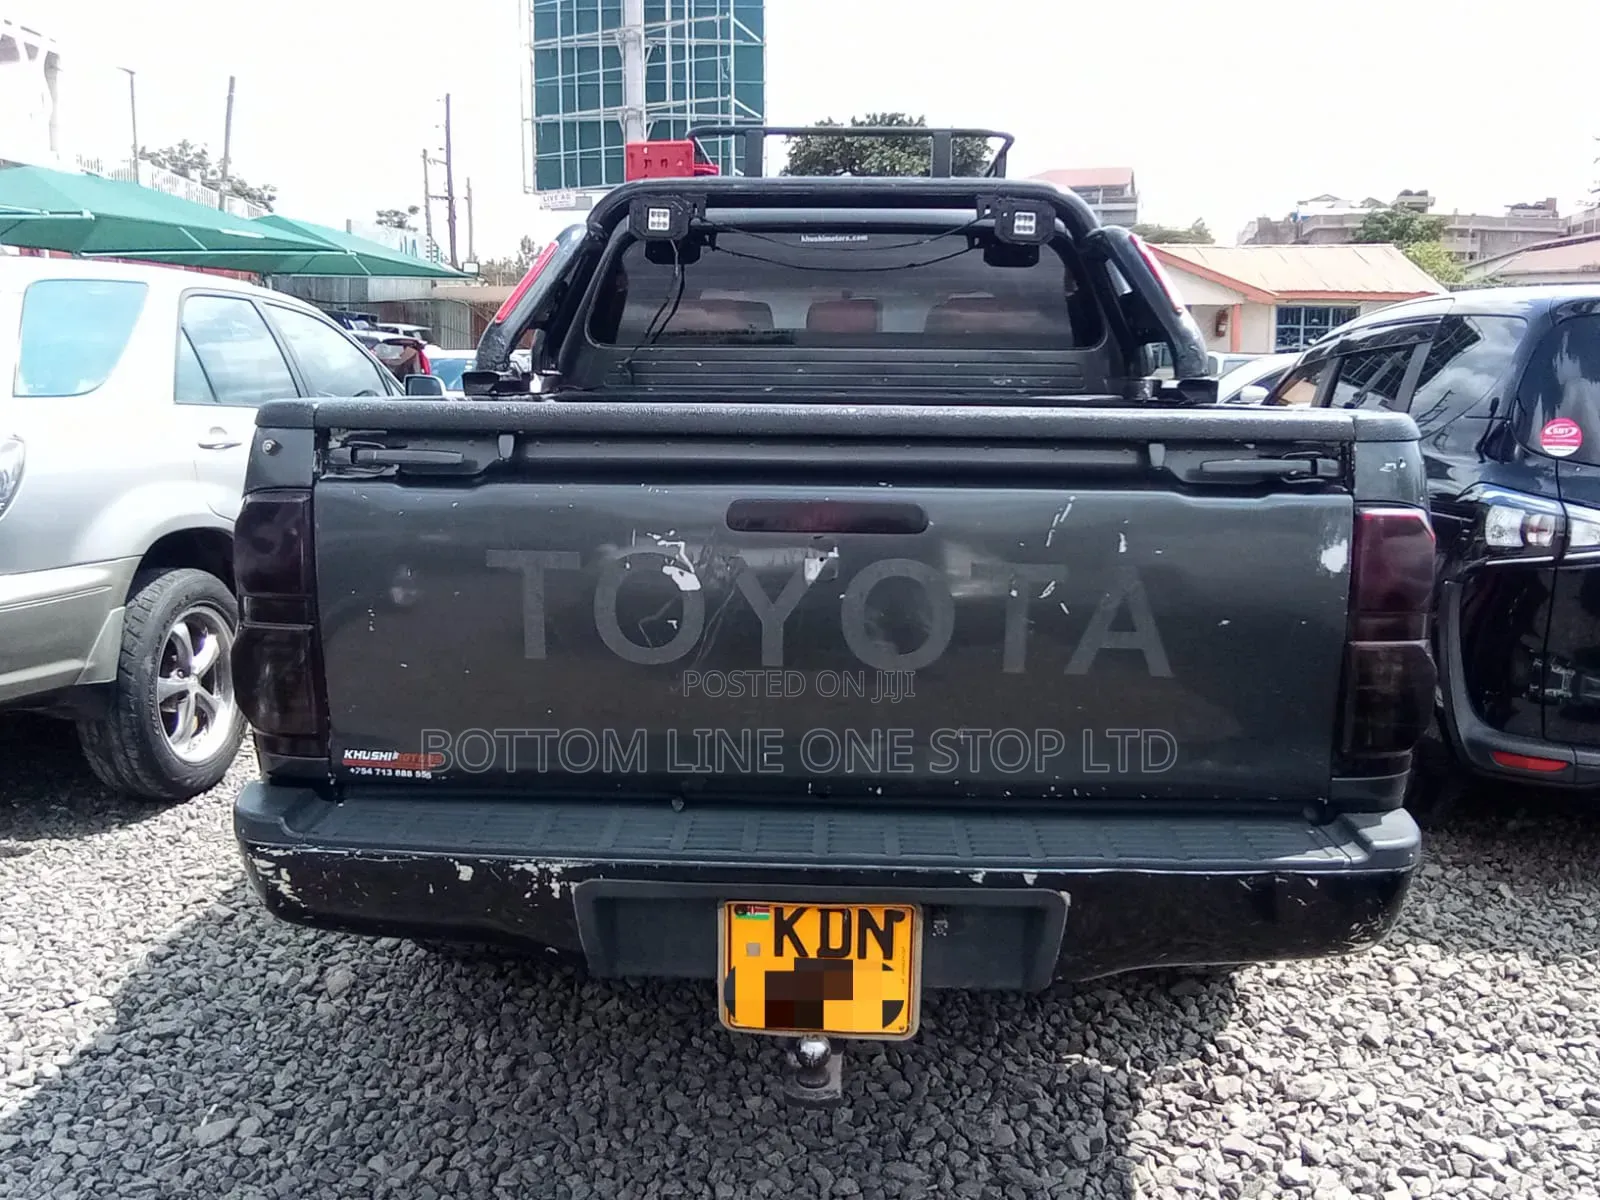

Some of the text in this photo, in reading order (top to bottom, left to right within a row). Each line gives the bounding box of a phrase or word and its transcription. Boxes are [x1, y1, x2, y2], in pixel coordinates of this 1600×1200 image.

[486, 549, 1172, 677] TOYOTA
[343, 749, 392, 761] KHUSHI
[774, 906, 896, 960] KDN
